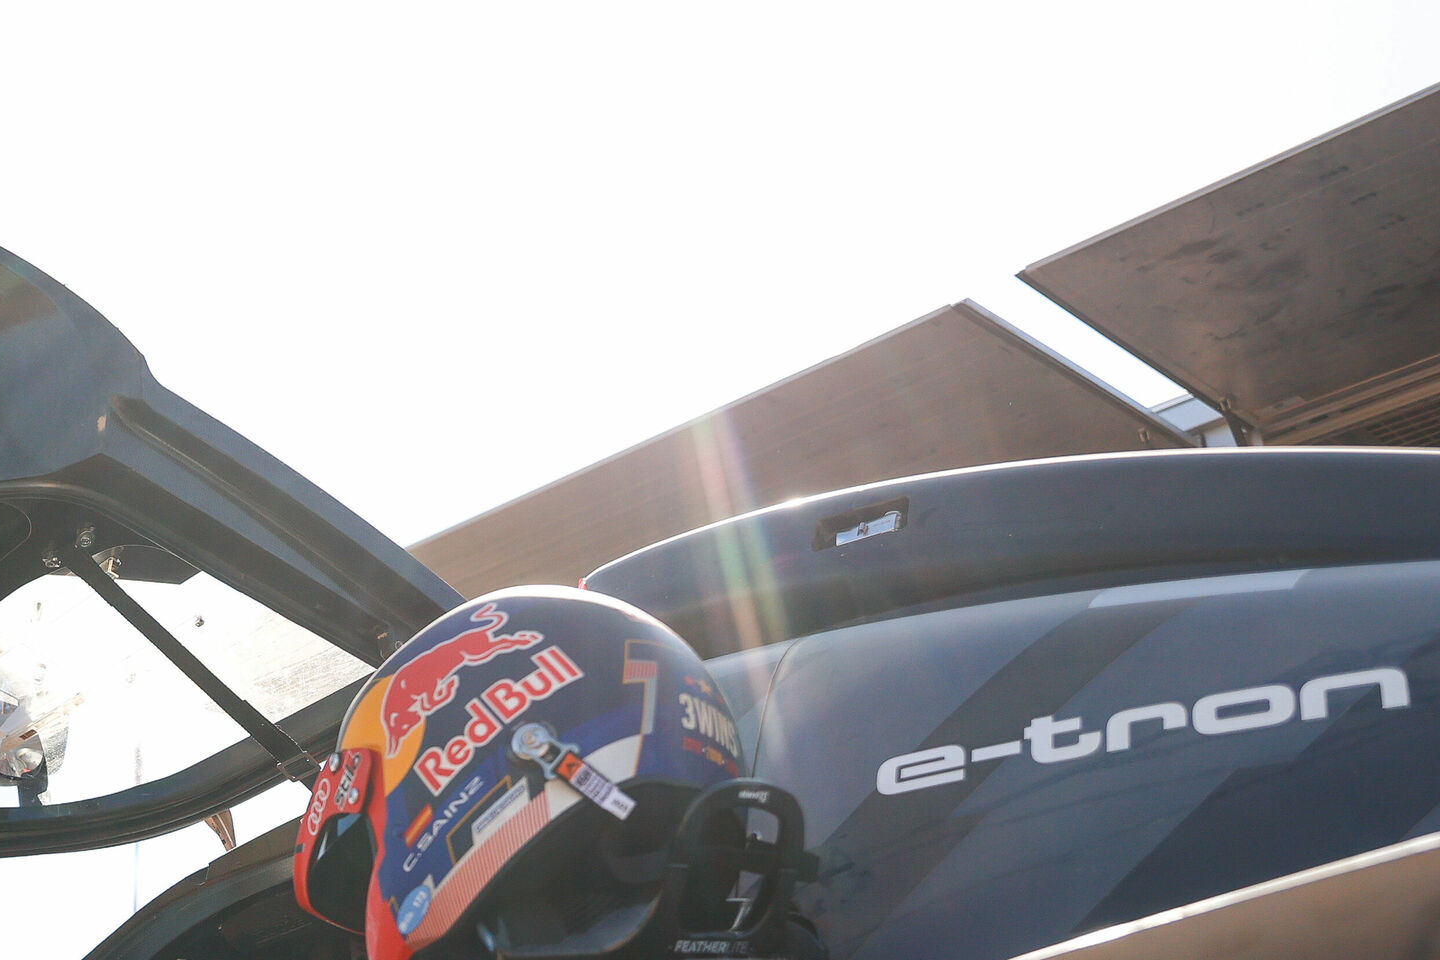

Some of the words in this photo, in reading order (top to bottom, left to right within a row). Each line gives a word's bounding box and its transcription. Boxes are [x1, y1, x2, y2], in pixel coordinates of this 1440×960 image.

[413, 697, 503, 796] Red
[480, 645, 585, 724] Bull
[876, 666, 1411, 796] e-tron
